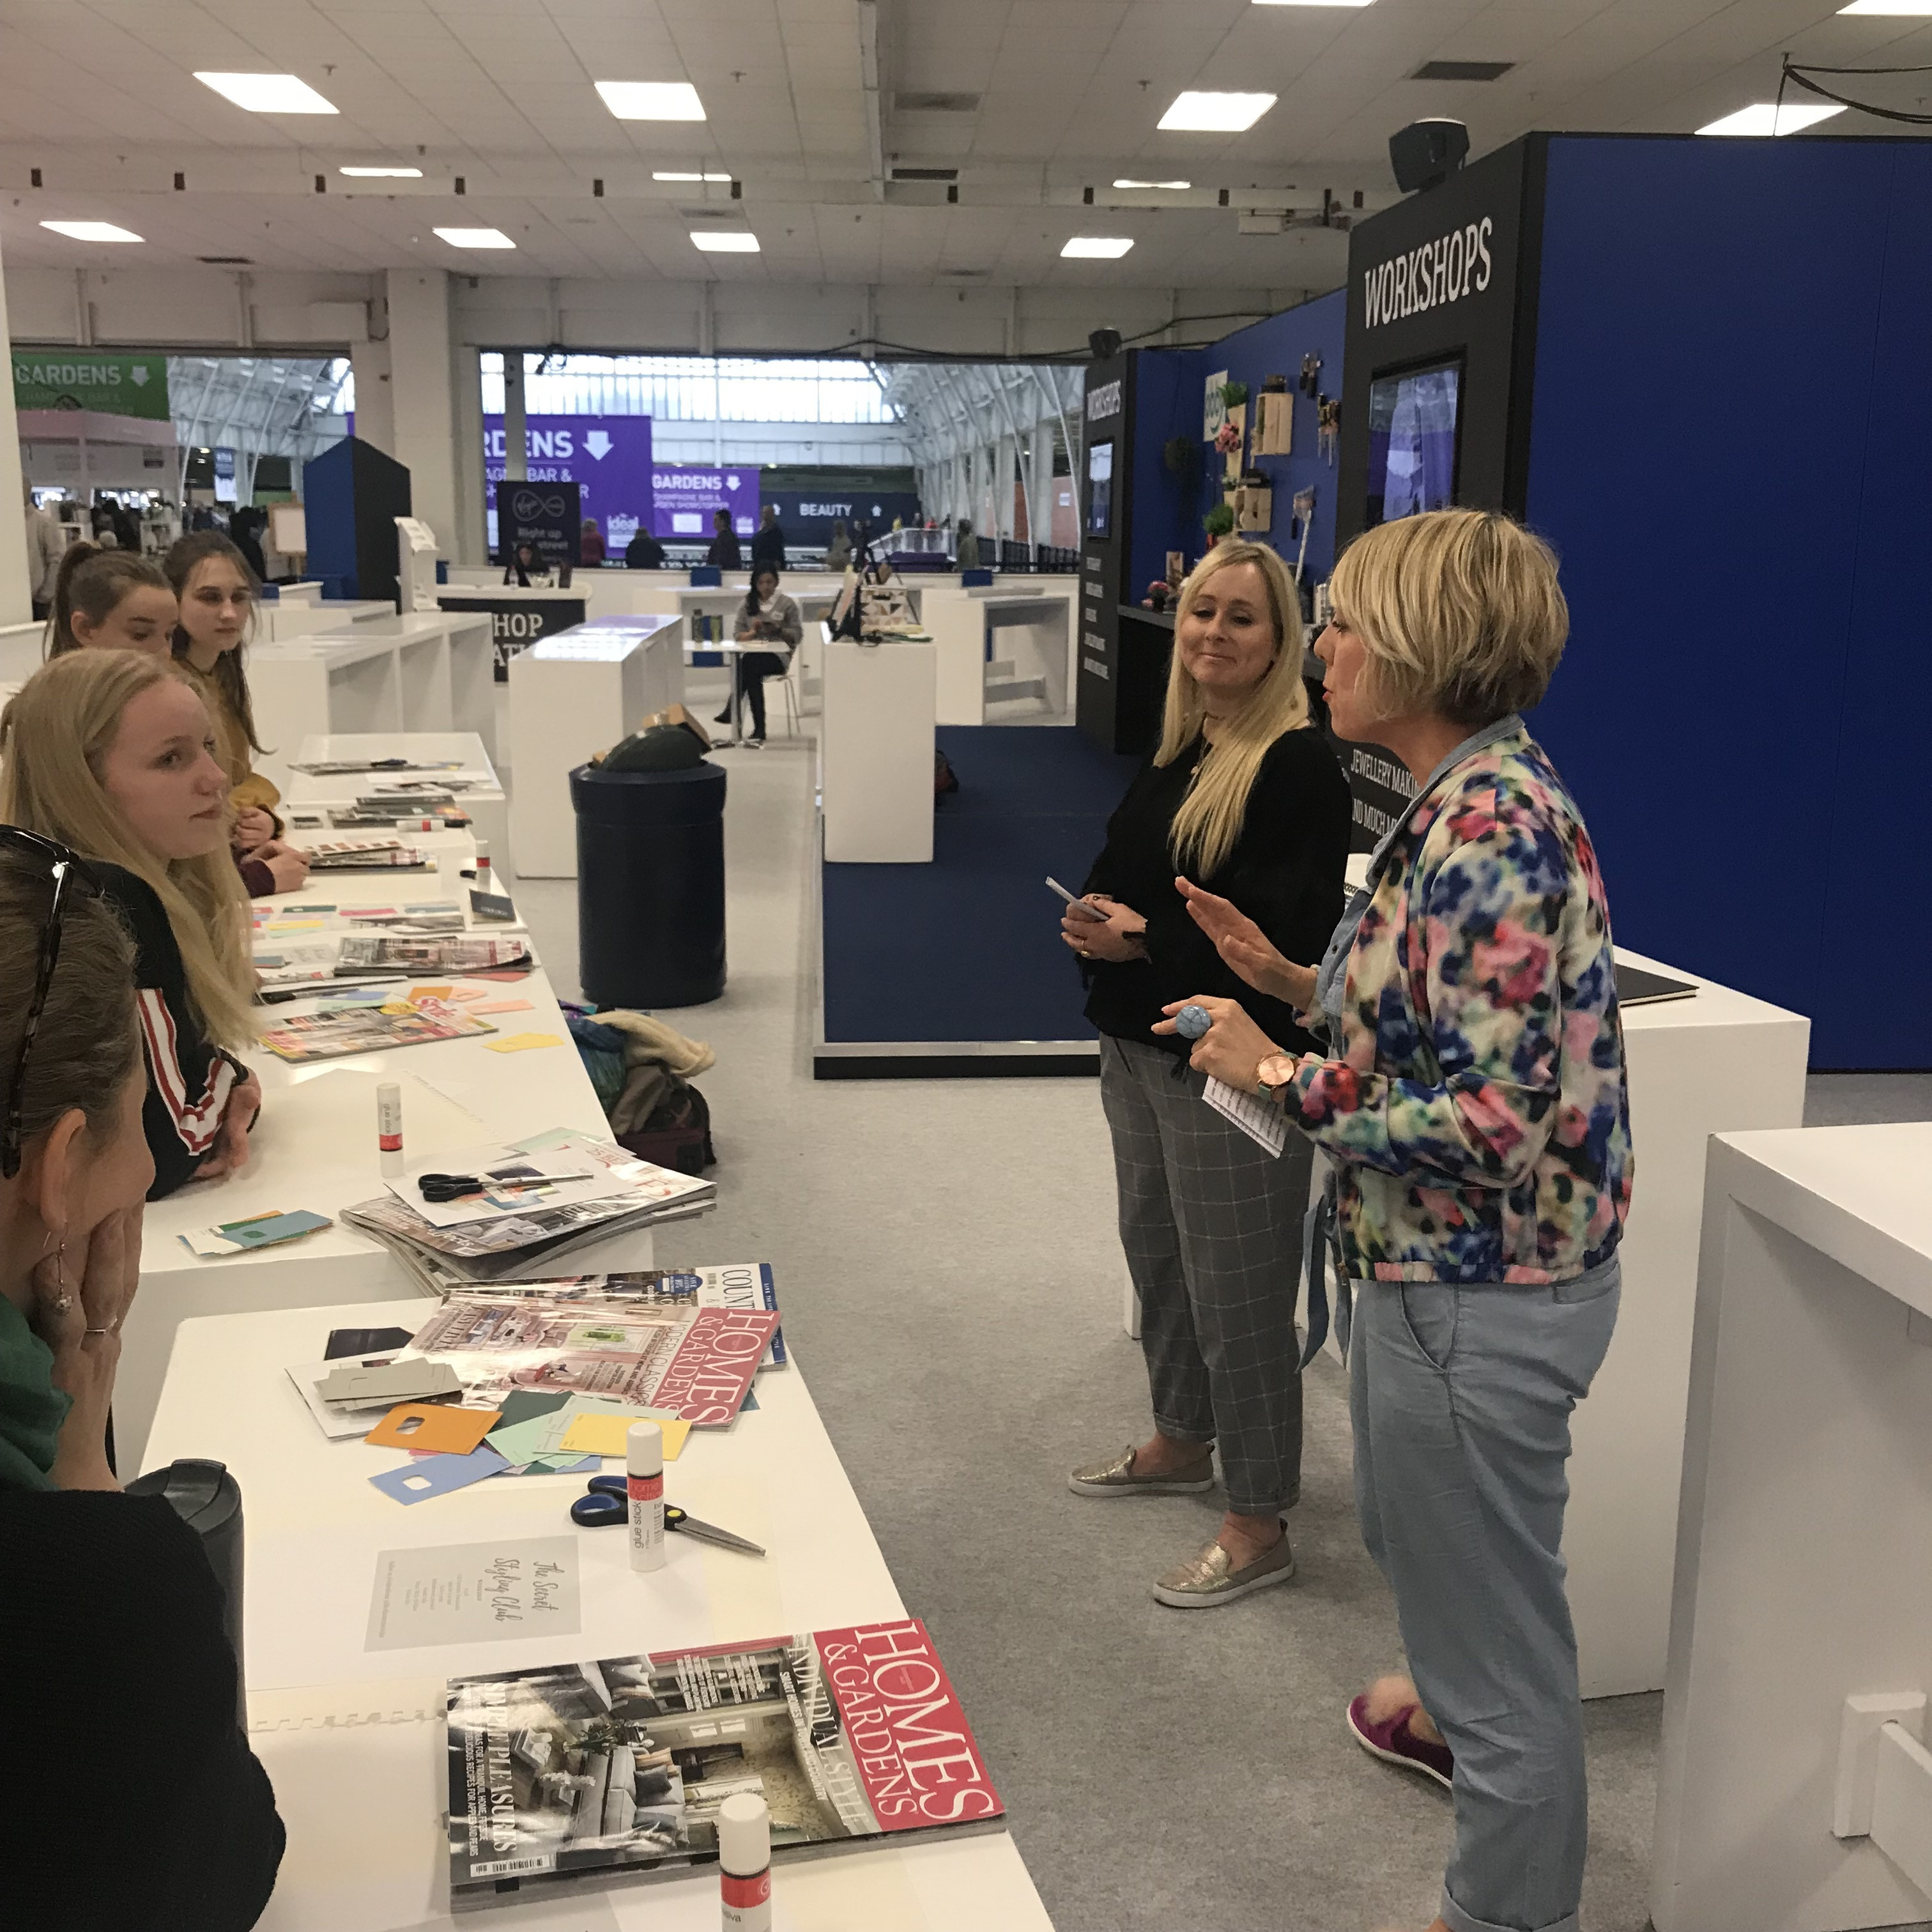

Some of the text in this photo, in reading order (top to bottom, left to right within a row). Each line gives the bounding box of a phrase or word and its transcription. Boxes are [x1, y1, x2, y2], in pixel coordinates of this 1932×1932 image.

[1365, 216, 1492, 330] WORKSHOPS
[15, 364, 122, 385] GARDENS
[526, 467, 557, 482] BAR
[560, 467, 572, 482] &
[652, 473, 723, 490] GARDENS
[799, 502, 852, 517] BEAUTY
[493, 613, 543, 638] HOP
[1351, 748, 1392, 789] JEWELLERY
[1363, 804, 1386, 838] MUCH
[696, 1316, 724, 1327] &
[654, 1328, 717, 1411] GARDENS
[678, 1312, 775, 1425] HOMES
[629, 1481, 659, 1492] home
[633, 1501, 645, 1549] glue stick
[483, 1556, 523, 1622] Styling Club
[532, 1559, 565, 1612] The Secret
[778, 1671, 795, 1694] SMART
[785, 1694, 802, 1717] HOMES
[823, 1643, 918, 1817] & GARDENS
[855, 1620, 995, 1820] HOMES
[787, 1646, 870, 1827] INDIVIDUAL STYLE
[475, 1745, 483, 1758] FOR
[466, 1761, 475, 1787] RECIPES
[475, 1764, 485, 1795] TRANQUIL
[807, 1765, 829, 1801] COUNTRY
[466, 1788, 475, 1801] FOR
[487, 1744, 516, 1853] PLEASURES
[466, 1802, 476, 1824] APPLES
[467, 1824, 477, 1837] AND
[468, 1837, 477, 1857] PEARS
